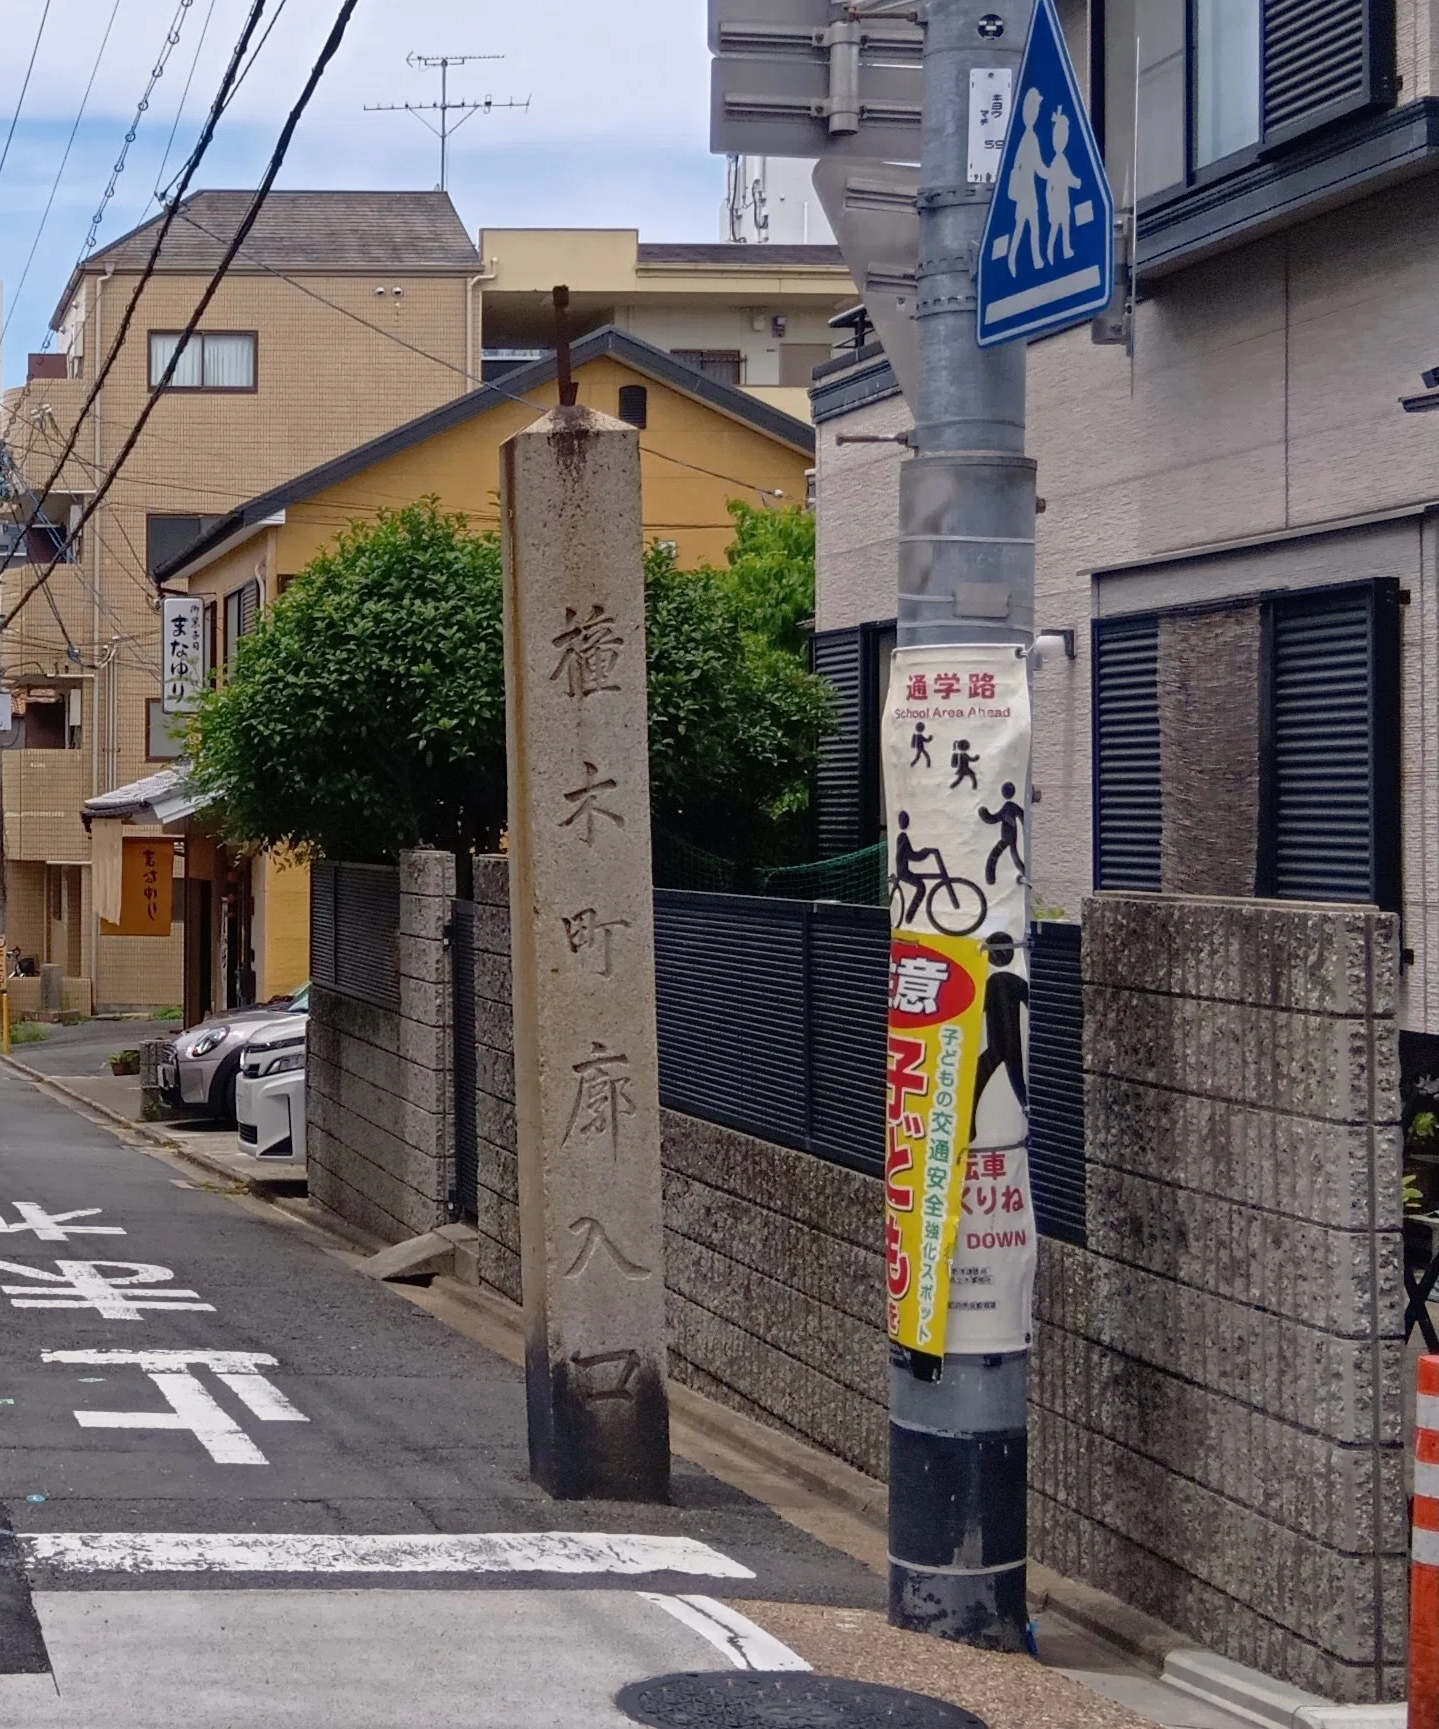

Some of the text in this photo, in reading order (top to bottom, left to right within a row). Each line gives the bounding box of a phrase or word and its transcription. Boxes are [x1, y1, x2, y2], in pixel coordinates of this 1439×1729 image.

[170, 614, 190, 704] まなゆり
[906, 673, 995, 700] 通学路
[895, 706, 1010, 719] School Area Ahead
[889, 956, 949, 1015] 意
[918, 1029, 958, 1342] 子どもの交通安全強化スポット
[967, 1230, 1026, 1249] DOWN
